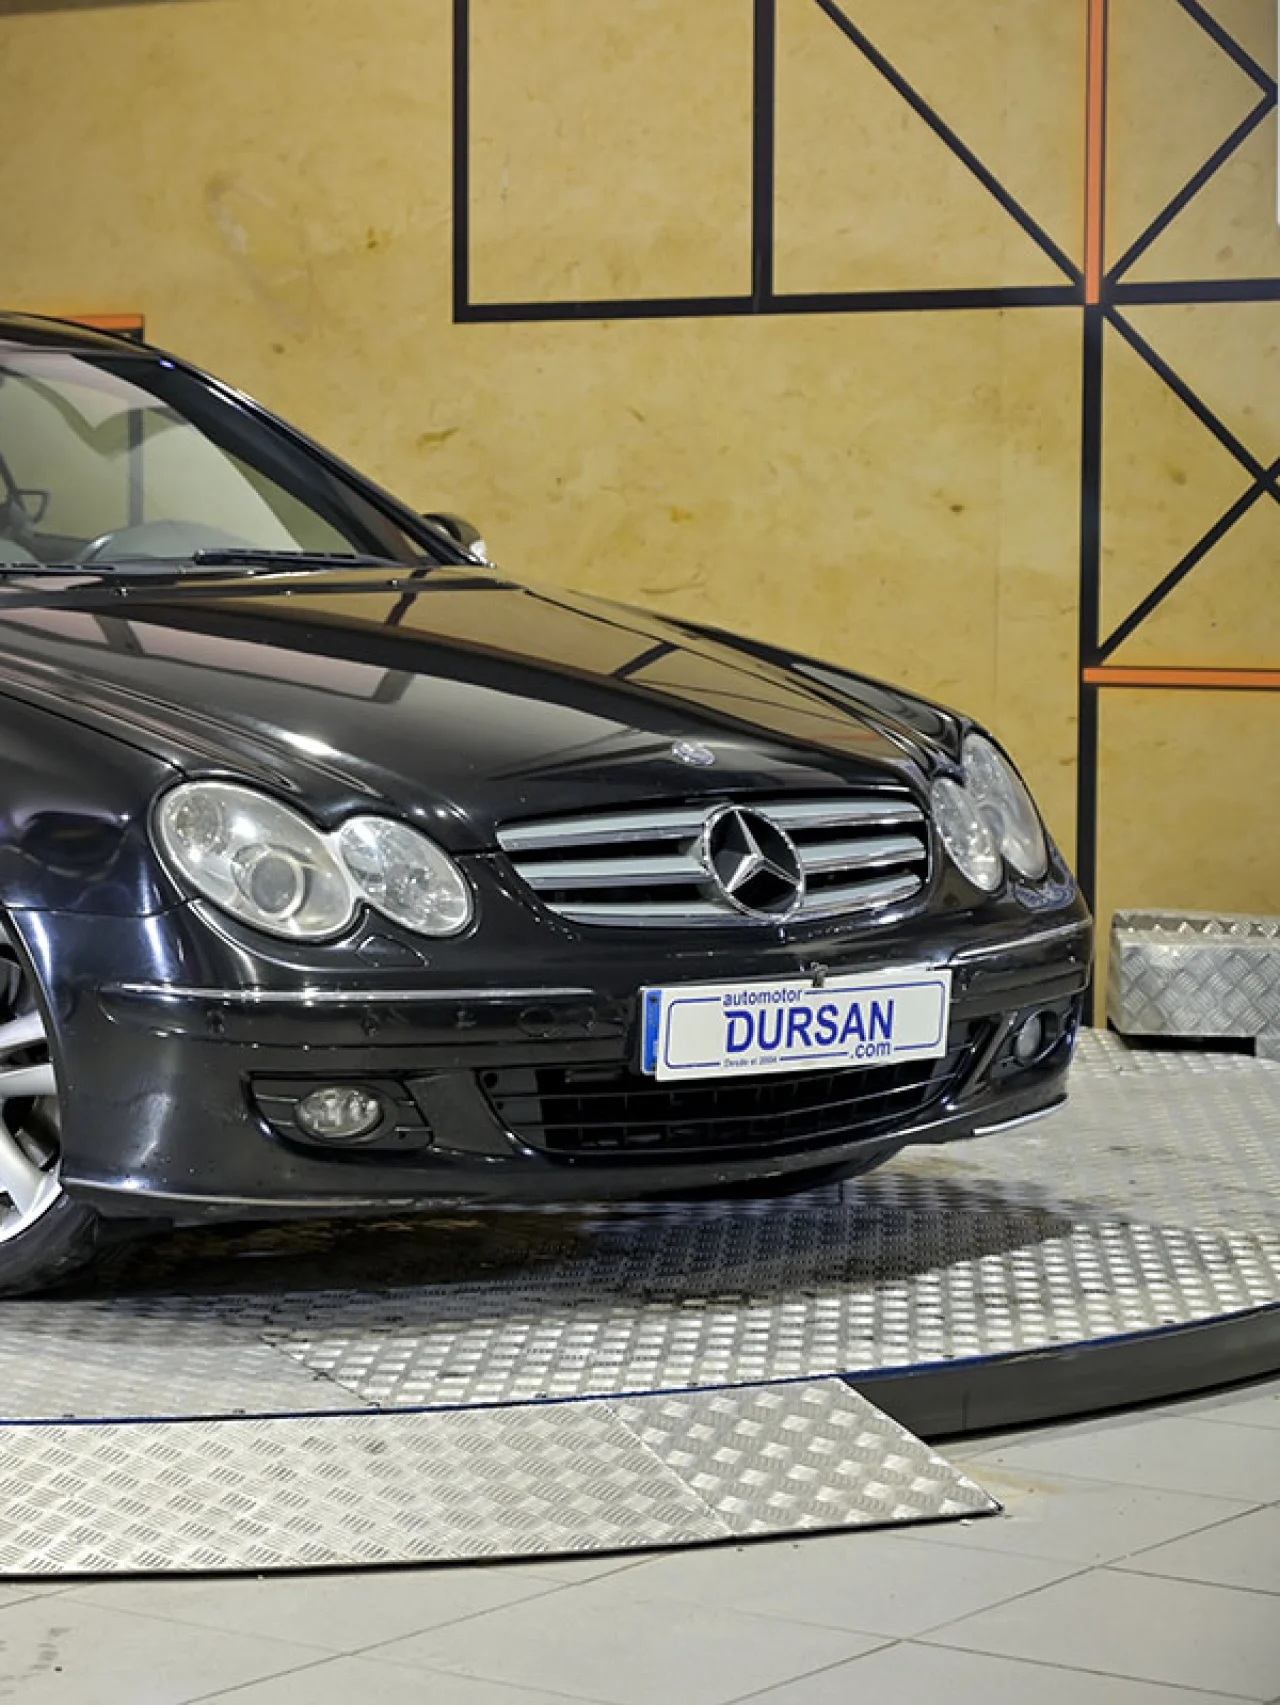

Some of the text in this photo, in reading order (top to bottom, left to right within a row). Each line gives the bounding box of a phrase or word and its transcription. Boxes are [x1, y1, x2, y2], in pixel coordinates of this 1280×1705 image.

[722, 988, 803, 1006] automotor
[723, 999, 895, 1053] DURSAN
[849, 1040, 891, 1059] .com
